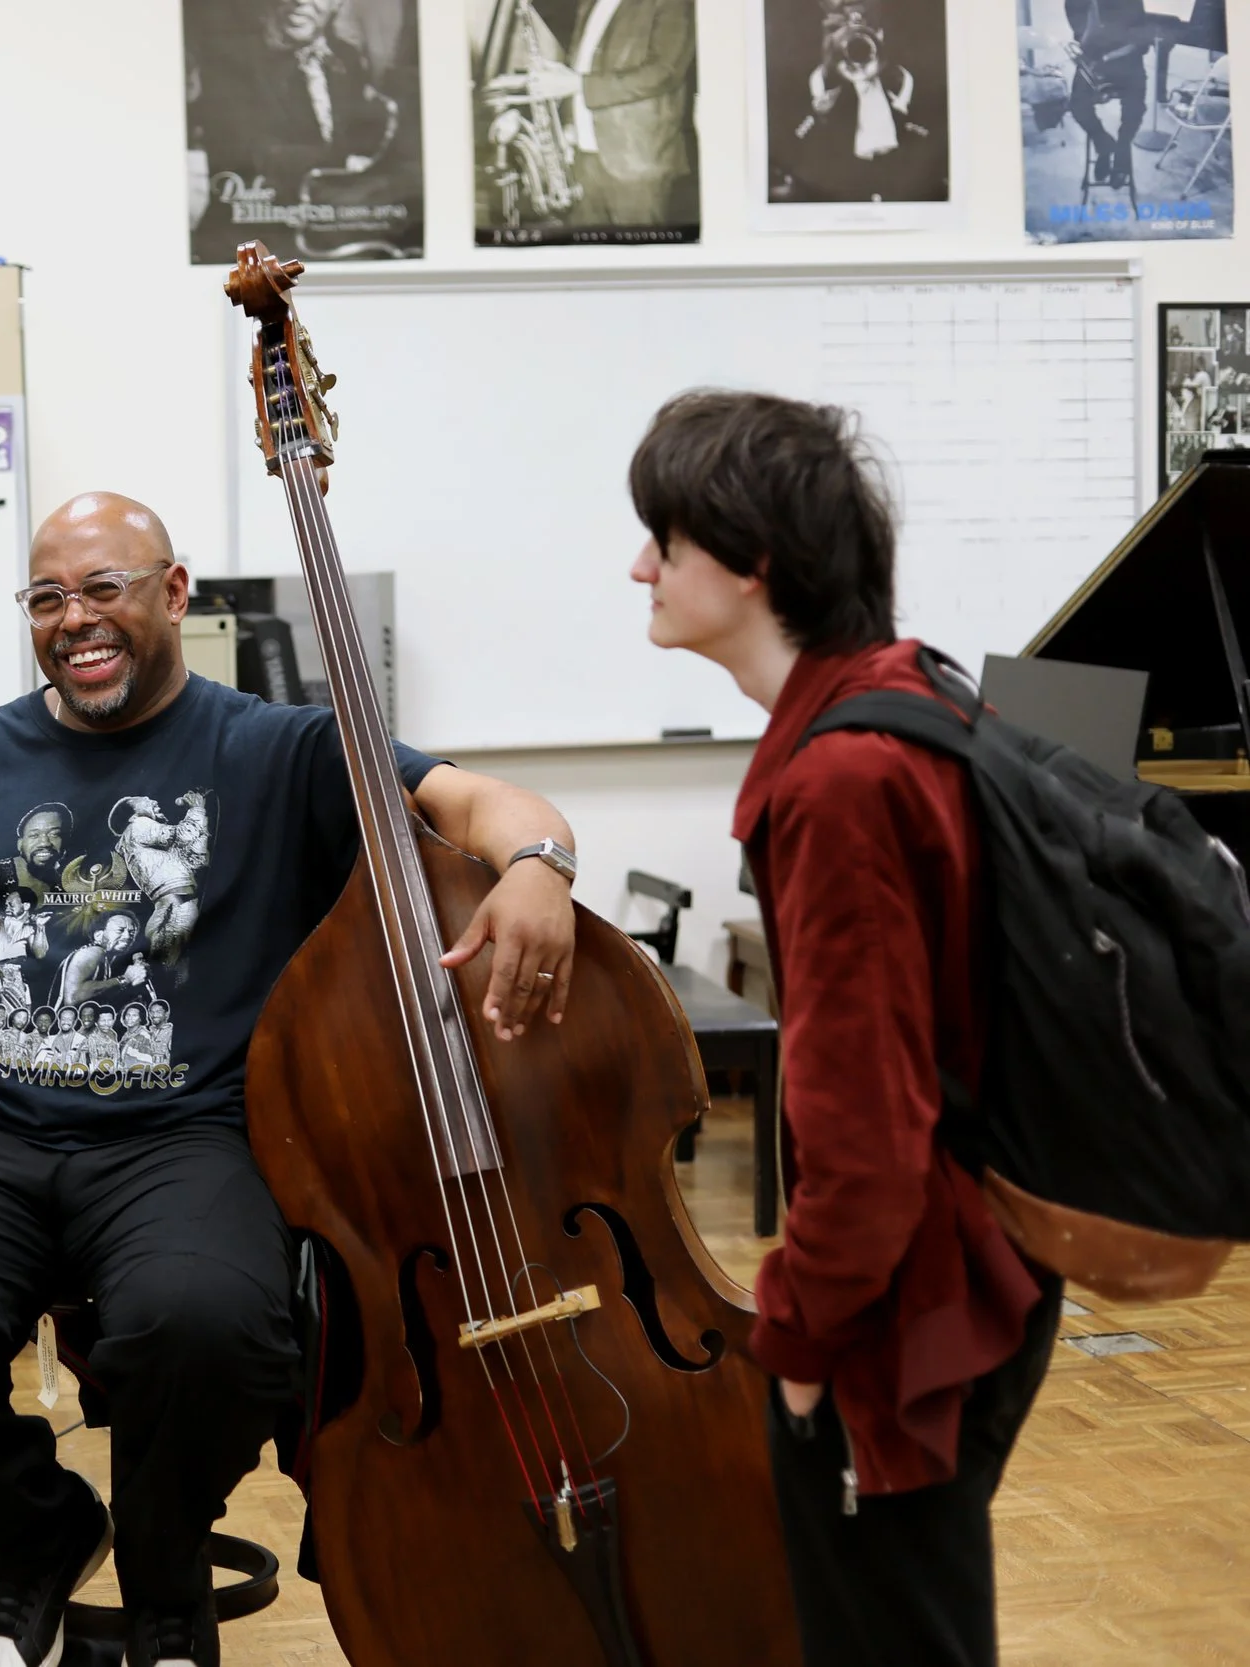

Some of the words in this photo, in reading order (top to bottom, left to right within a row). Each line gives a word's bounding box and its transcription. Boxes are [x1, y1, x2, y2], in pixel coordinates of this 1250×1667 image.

[232, 201, 336, 228] Ellington
[1050, 203, 1129, 223] MILES
[1138, 201, 1213, 220] DAVIS
[101, 890, 141, 901] WHITE
[16, 1058, 89, 1088] WIND
[124, 1063, 189, 1089] FIRE
